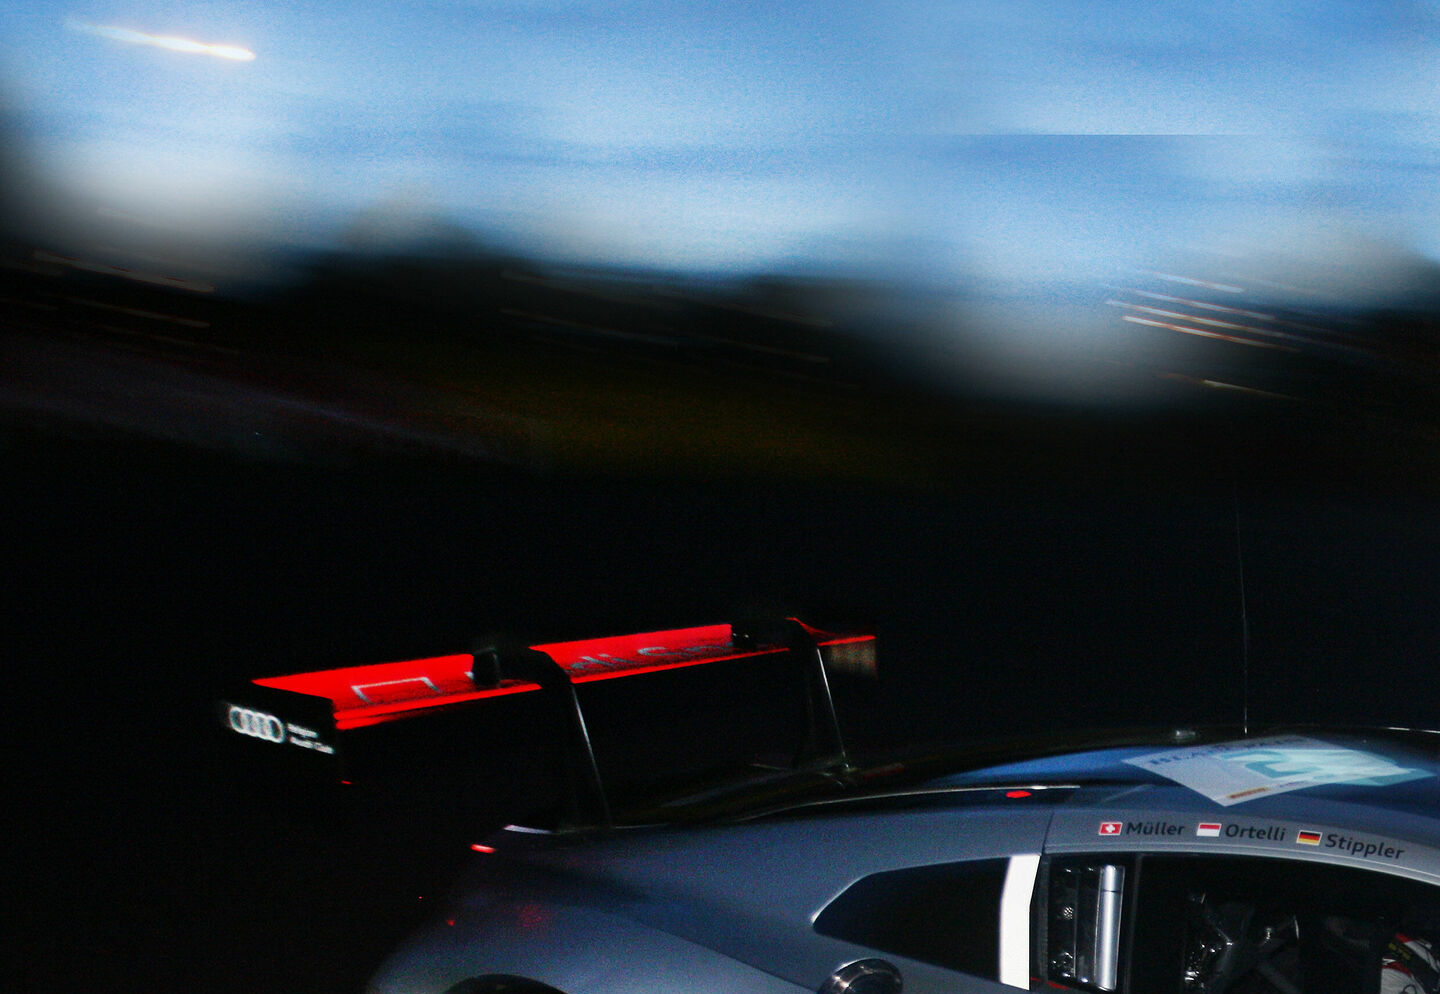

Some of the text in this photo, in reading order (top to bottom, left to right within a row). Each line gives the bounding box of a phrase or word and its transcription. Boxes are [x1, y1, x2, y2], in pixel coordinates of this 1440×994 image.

[1126, 820, 1185, 836] Müller
[1225, 822, 1286, 842] Ortelli
[1325, 833, 1405, 860] Stippler
